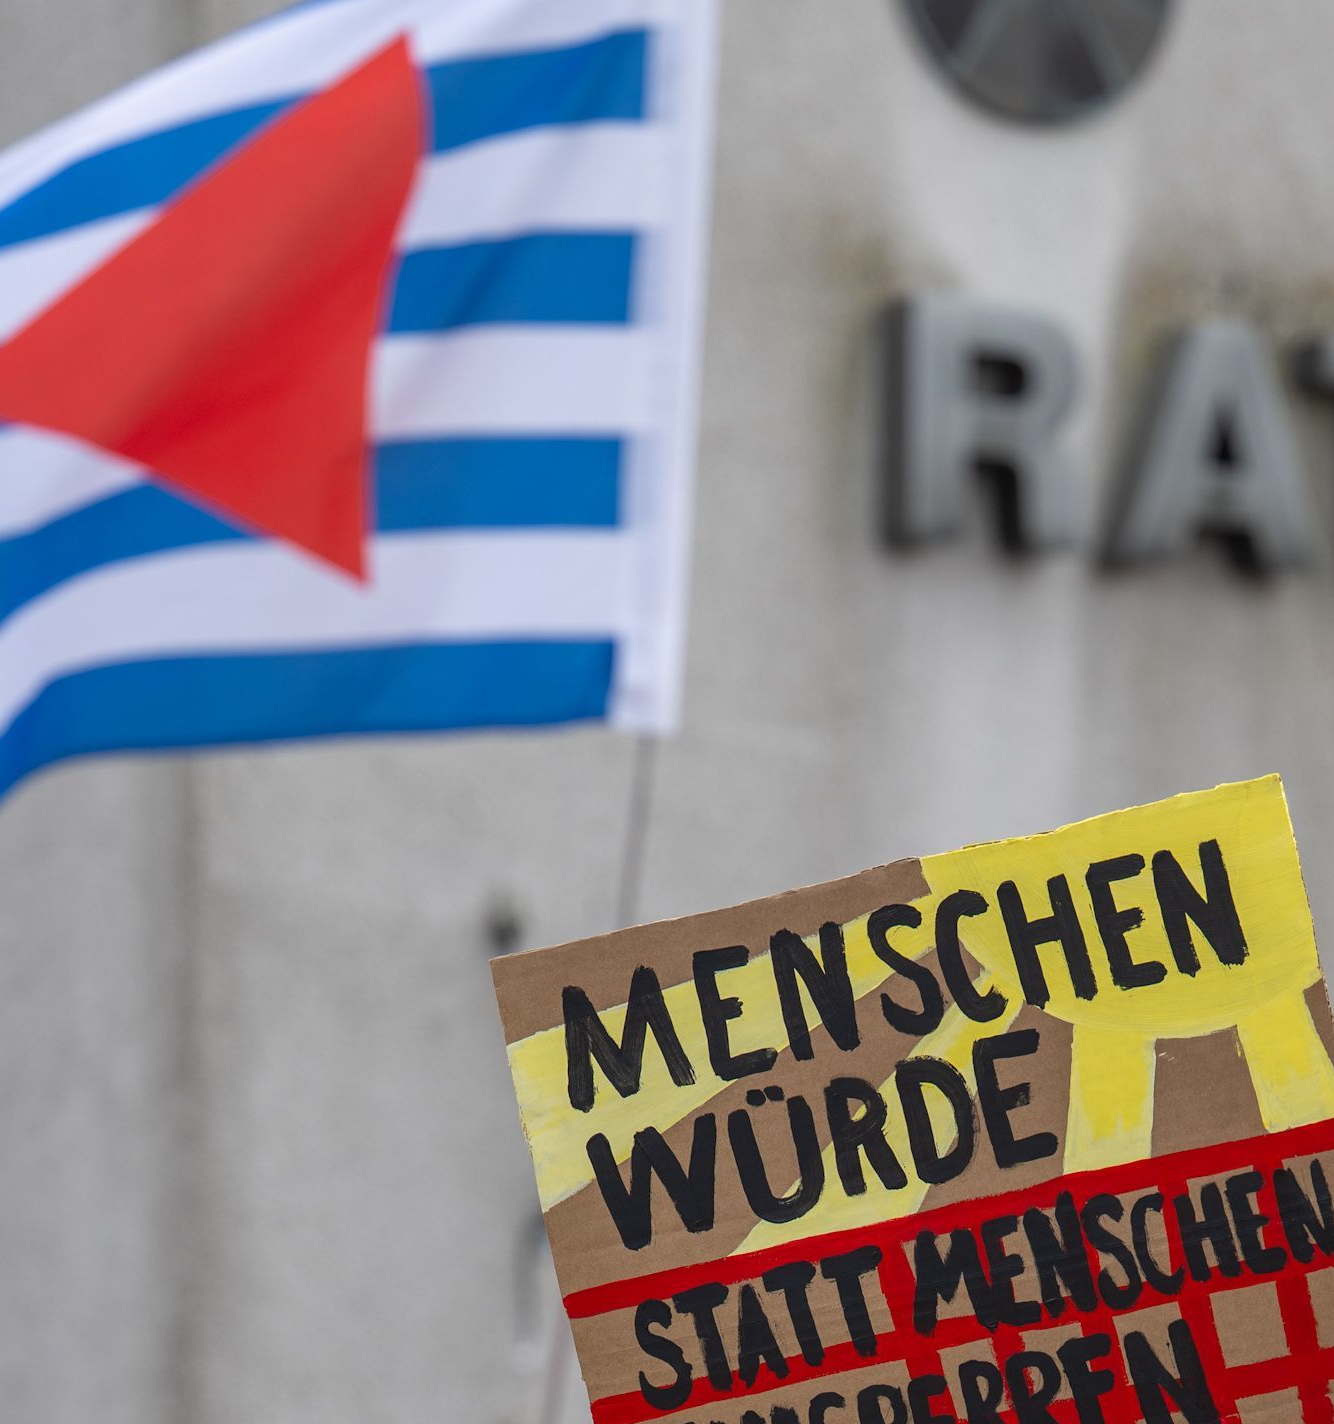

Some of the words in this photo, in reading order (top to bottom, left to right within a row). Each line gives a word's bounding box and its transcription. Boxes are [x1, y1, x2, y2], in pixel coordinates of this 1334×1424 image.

[561, 839, 1249, 1112] MENSCHEN
[587, 1028, 1059, 1252] WÜRDE
[634, 1245, 884, 1410] STATT
